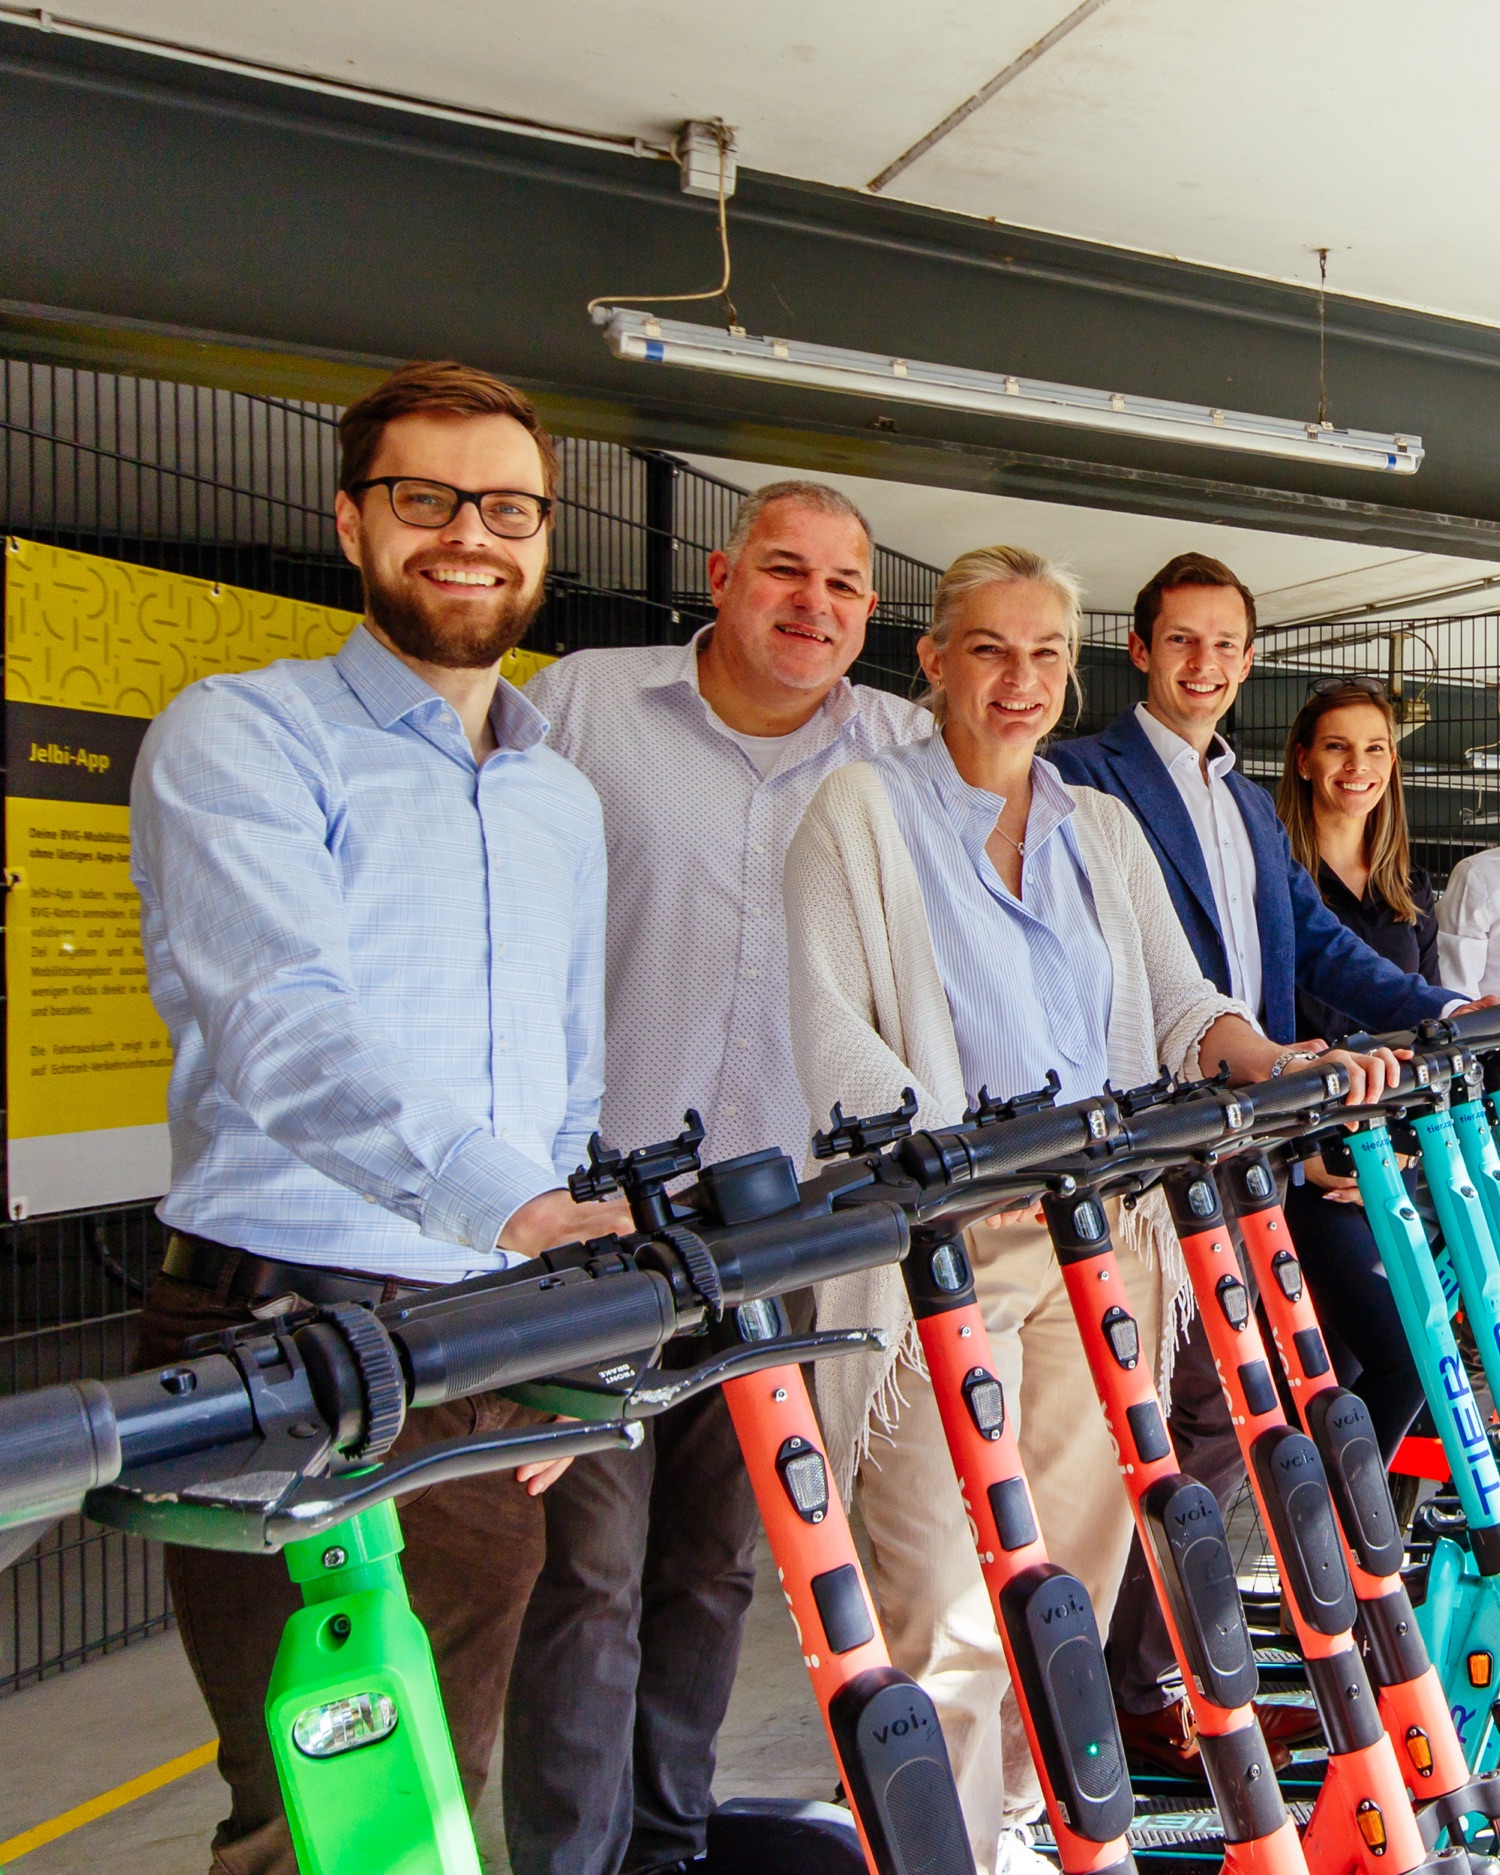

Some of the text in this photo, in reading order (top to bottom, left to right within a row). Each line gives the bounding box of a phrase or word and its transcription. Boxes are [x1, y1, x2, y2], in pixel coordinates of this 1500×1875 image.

[29, 743, 110, 773] Jelbi-App
[86, 928, 105, 938] und
[598, 1363, 630, 1379] BRAKE
[604, 1369, 636, 1385] FRONT
[1438, 1353, 1500, 1517] TIER
